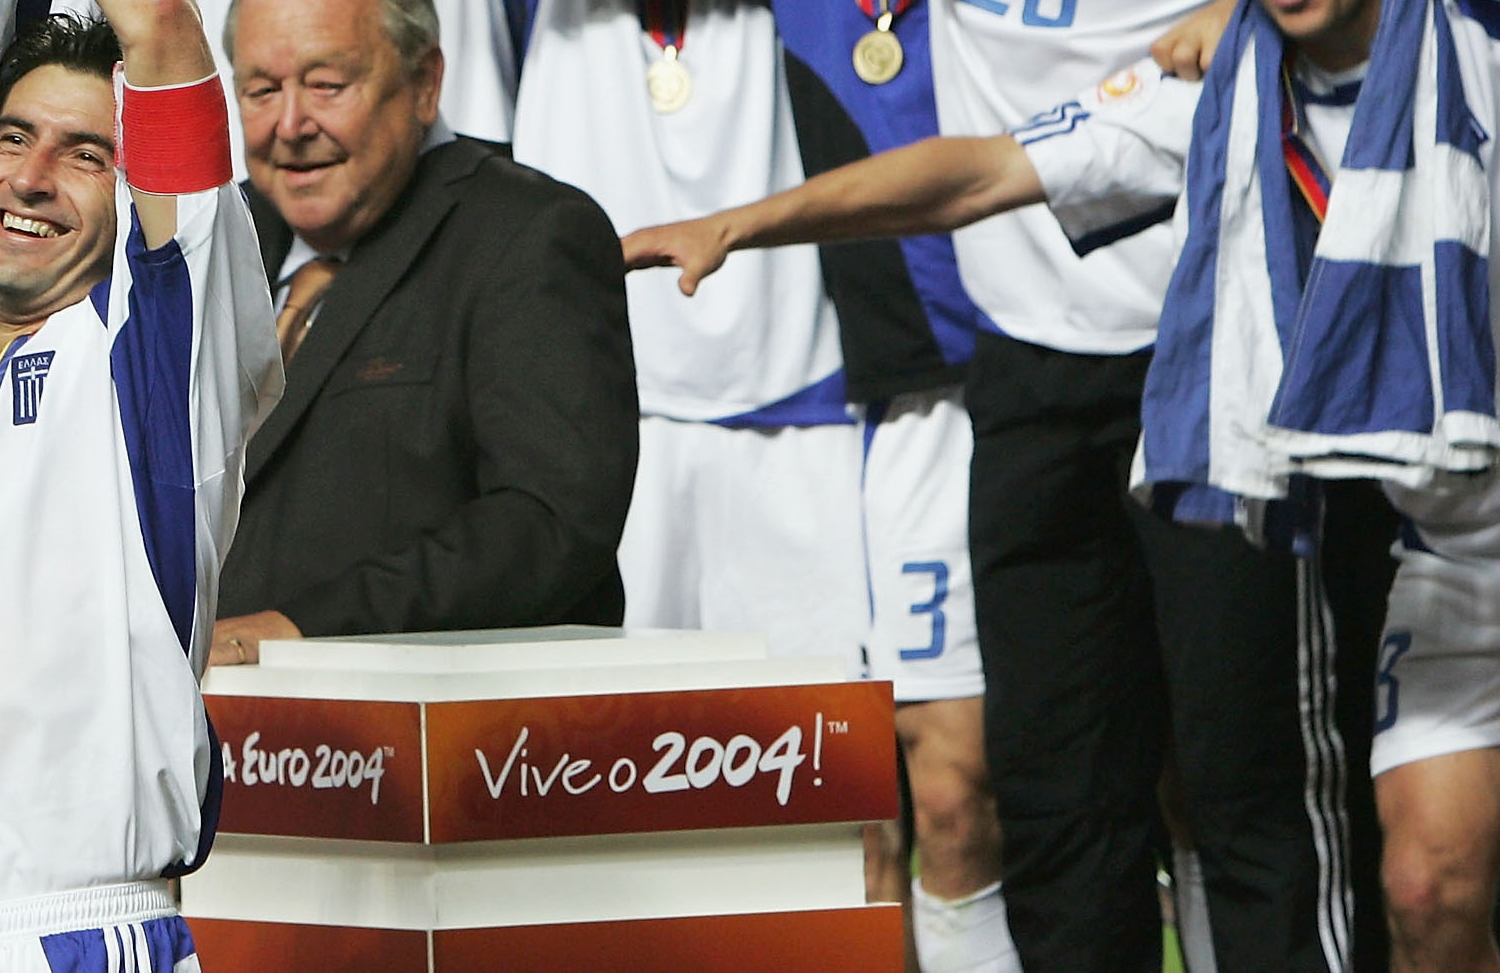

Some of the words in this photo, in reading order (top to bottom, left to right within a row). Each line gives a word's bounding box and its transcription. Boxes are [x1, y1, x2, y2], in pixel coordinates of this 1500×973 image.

[18, 356, 50, 370] ΕΛΛΑΣ
[899, 561, 949, 660] 3
[241, 731, 310, 787] Euro
[311, 744, 386, 805] 2004
[474, 726, 602, 800] Vive
[608, 758, 637, 793] o
